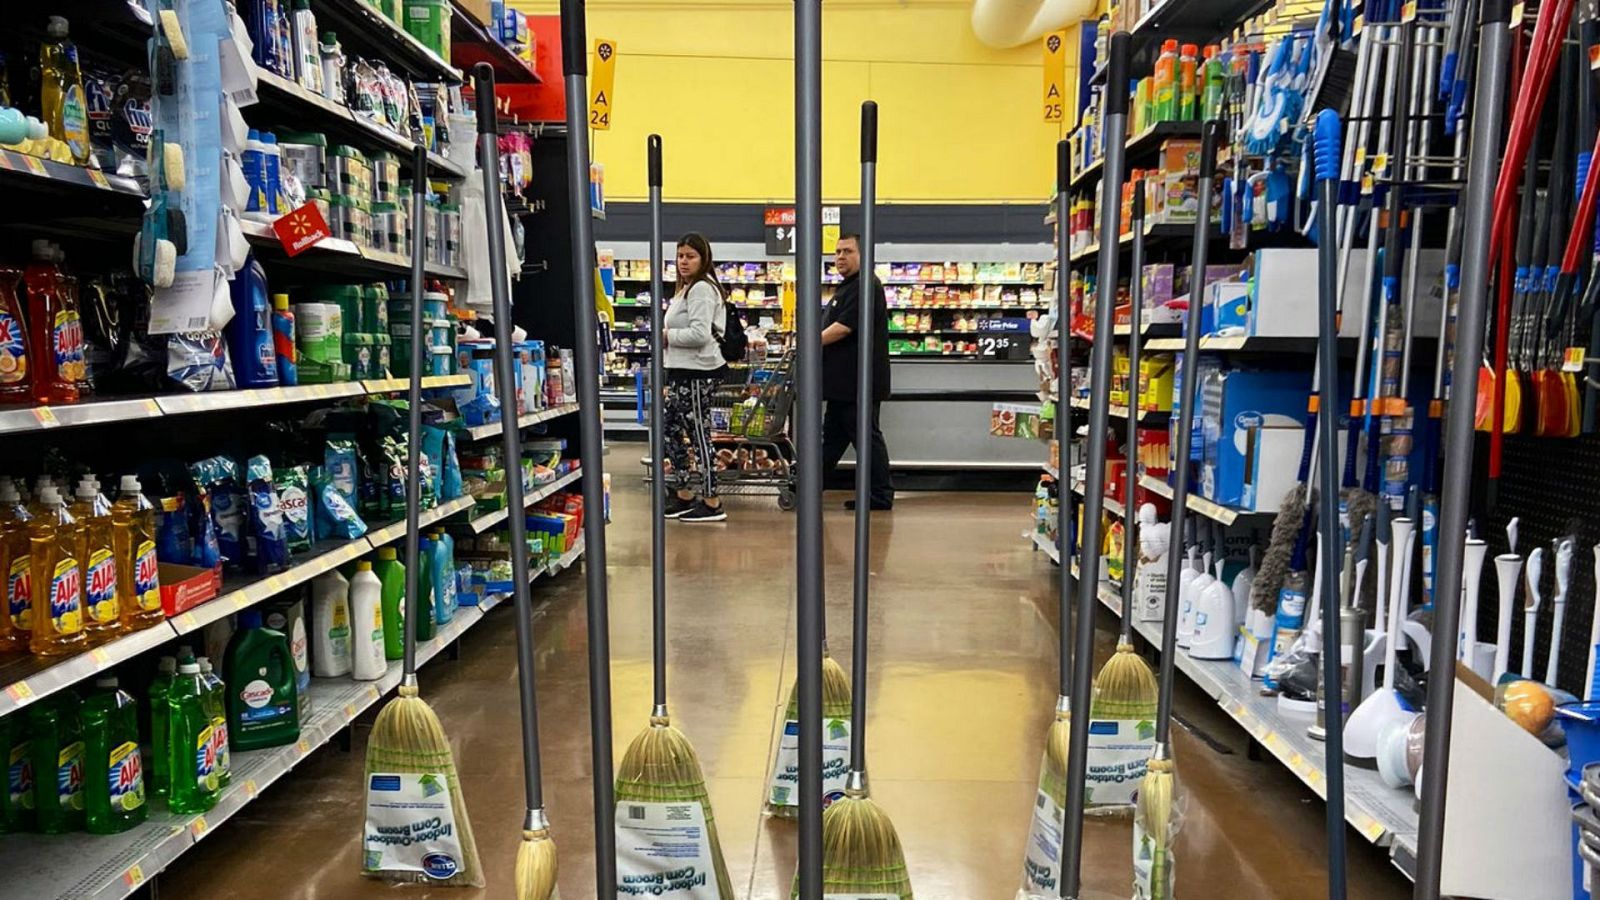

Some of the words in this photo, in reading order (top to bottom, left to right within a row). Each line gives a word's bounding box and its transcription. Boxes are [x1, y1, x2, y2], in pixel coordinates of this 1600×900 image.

[594, 90, 608, 106] A
[1047, 83, 1060, 98] A
[591, 109, 609, 126] 24
[1044, 104, 1062, 119] 25
[292, 229, 325, 250] Rollback
[1089, 764, 1126, 775] Broom
[377, 825, 411, 836] Broom
[411, 816, 441, 832] Corn
[366, 823, 452, 847] Indoor-Outdoor
[622, 872, 664, 885] Broom
